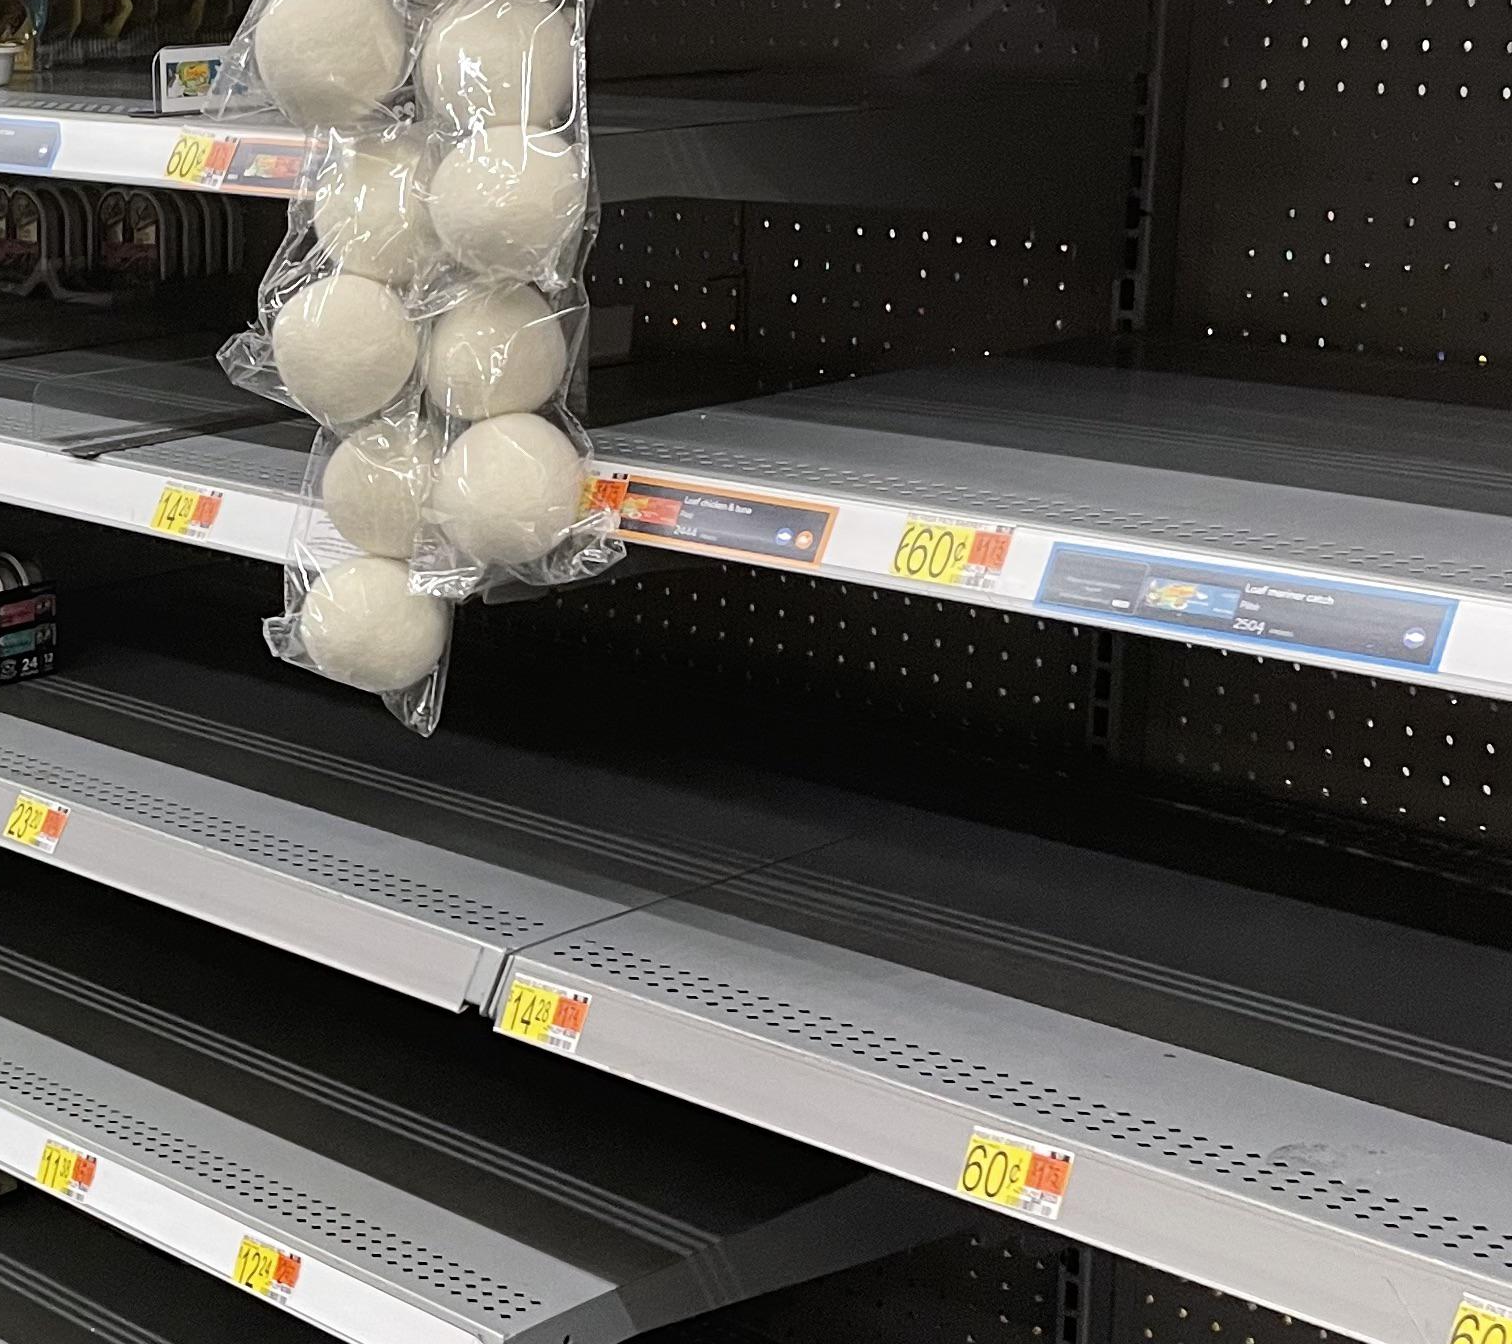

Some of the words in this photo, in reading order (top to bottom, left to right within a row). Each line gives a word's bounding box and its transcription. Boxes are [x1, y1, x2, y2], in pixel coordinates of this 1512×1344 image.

[166, 136, 203, 177] 60¢
[673, 523, 698, 537] 2444
[906, 527, 967, 579] 60¢
[1245, 582, 1269, 595] Loaf
[1306, 594, 1335, 605] catch
[21, 657, 38, 671] 24
[962, 1145, 1021, 1198] 60¢
